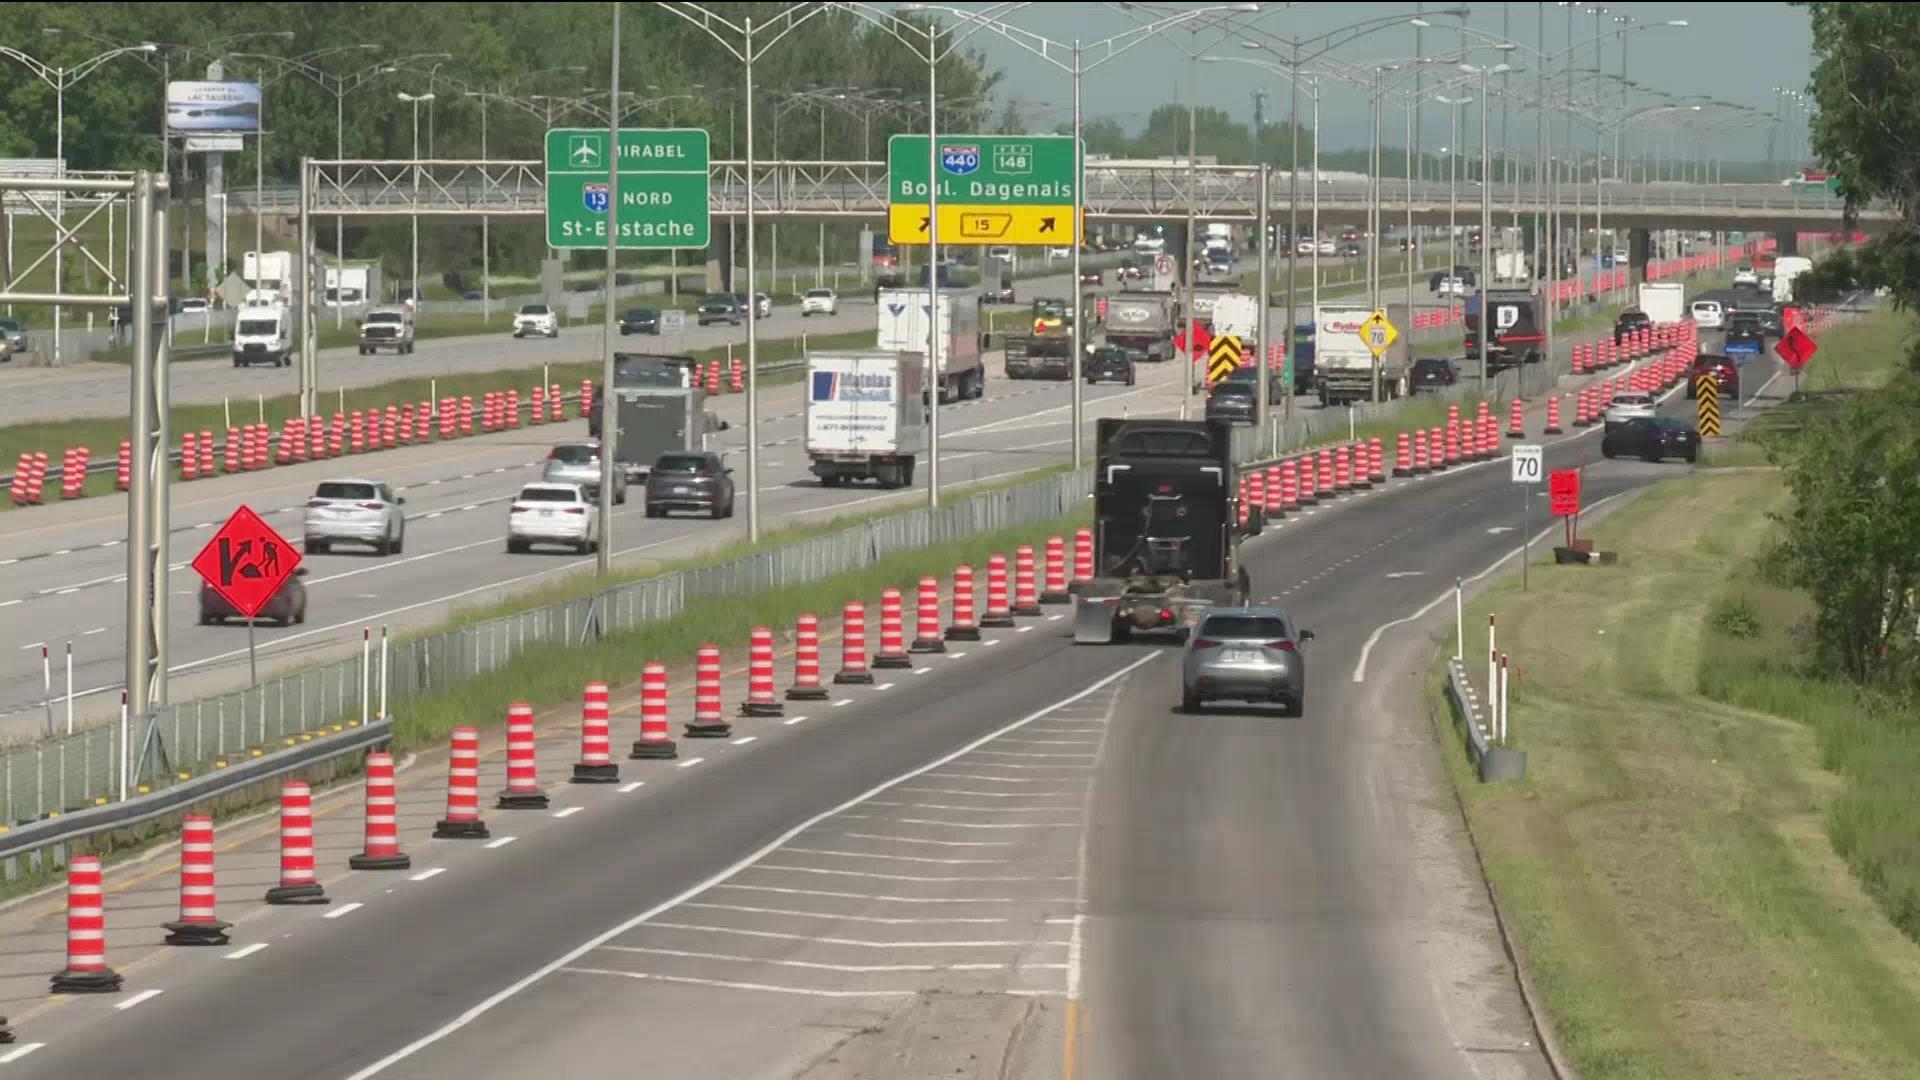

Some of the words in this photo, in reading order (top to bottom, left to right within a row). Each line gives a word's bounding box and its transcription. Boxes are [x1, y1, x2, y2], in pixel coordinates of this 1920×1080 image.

[945, 155, 976, 167] 440
[1000, 156, 1026, 168] 148
[970, 180, 1072, 200] Dagenais
[591, 193, 606, 205] 13
[623, 192, 673, 205] NORD
[975, 219, 990, 231] 15
[1371, 331, 1385, 344] 70
[1516, 457, 1538, 477] 70
